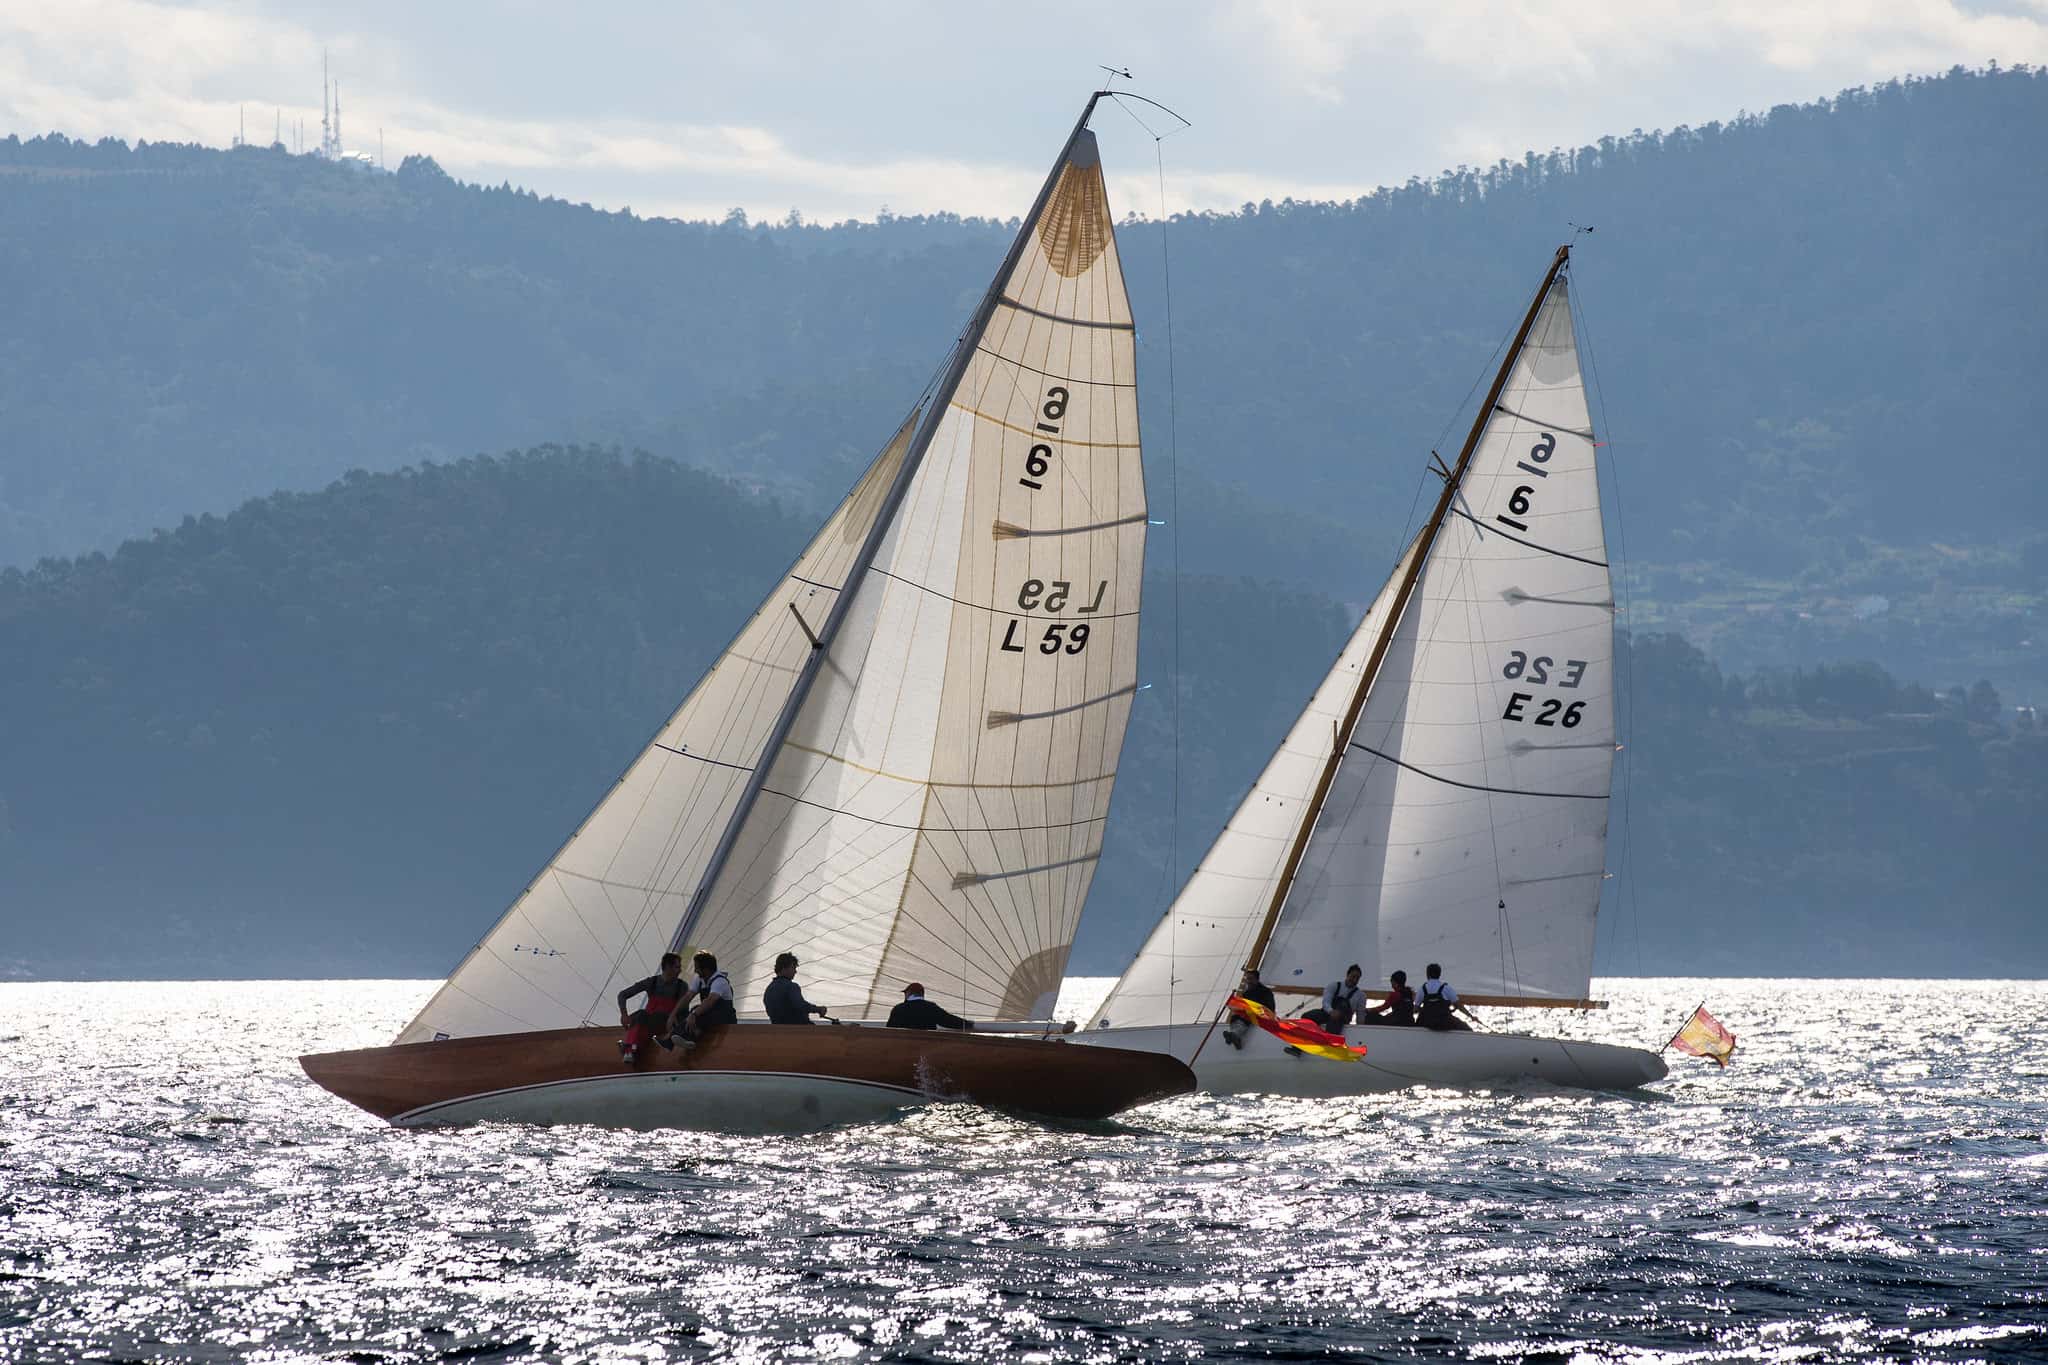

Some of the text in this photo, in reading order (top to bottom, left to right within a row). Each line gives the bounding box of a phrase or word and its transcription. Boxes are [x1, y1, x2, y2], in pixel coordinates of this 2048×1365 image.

[1025, 443, 1053, 478] 6
[1508, 485, 1535, 516] 6
[1001, 619, 1091, 656] L 59
[1502, 692, 1587, 729] E 26
